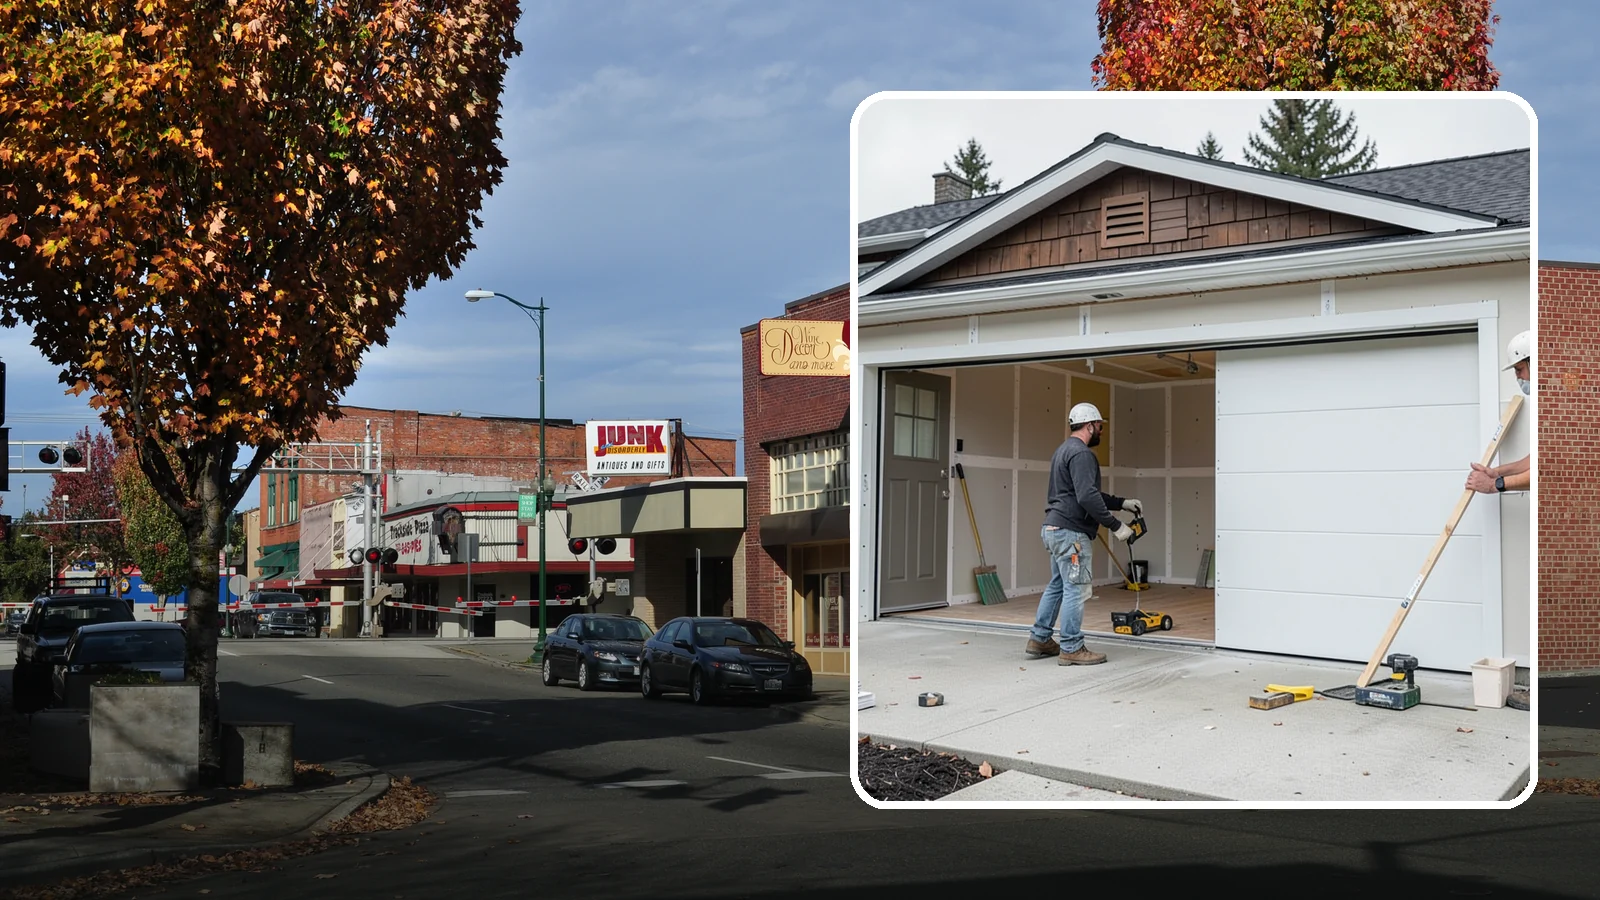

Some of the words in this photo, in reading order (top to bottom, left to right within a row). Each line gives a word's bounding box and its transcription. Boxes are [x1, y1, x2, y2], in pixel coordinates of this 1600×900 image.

[595, 425, 665, 457] JUNK
[607, 446, 646, 454] DISORDERLY
[597, 461, 628, 470] ANTIQUES
[631, 461, 644, 470] AND
[647, 460, 665, 470] GIFTS
[390, 522, 413, 539] Trackside
[414, 519, 429, 535] Pizza
